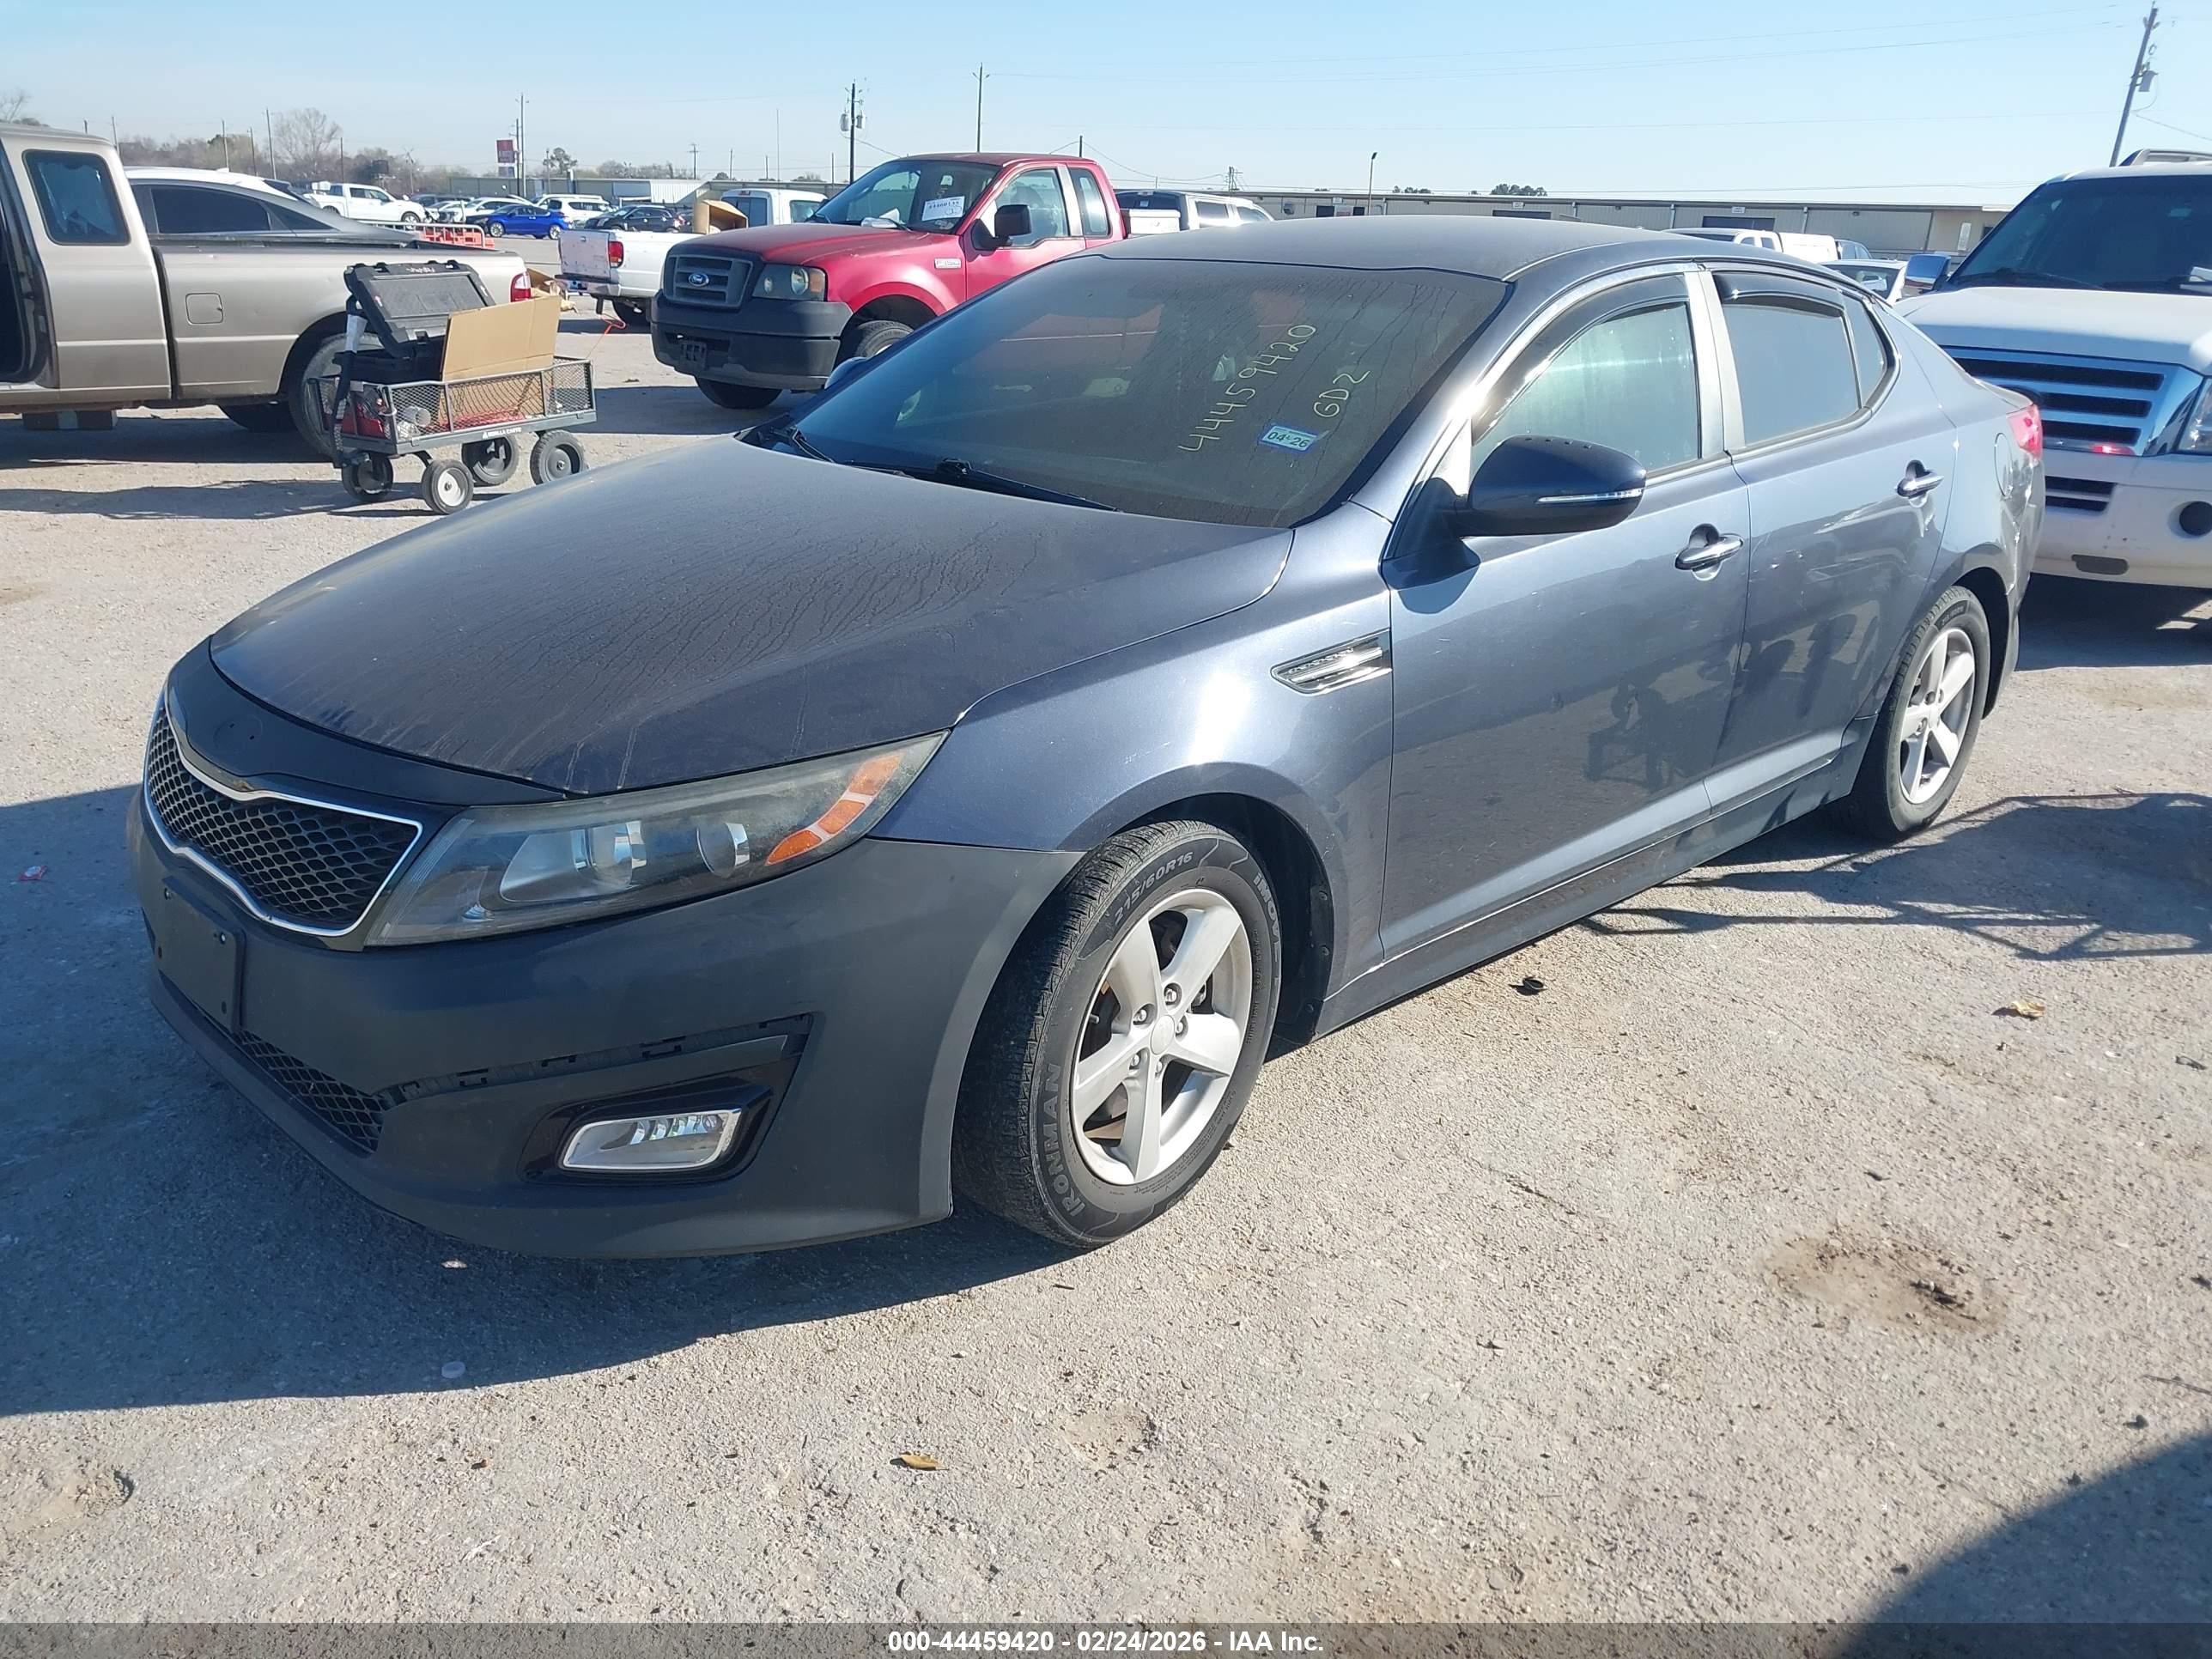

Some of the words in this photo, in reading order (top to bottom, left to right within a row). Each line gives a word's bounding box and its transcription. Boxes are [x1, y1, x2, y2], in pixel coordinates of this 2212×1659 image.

[1178, 325, 1317, 452] 44459420
[1115, 851, 1194, 926] 215/60R16
[1042, 1062, 1086, 1218] IRONMAN
